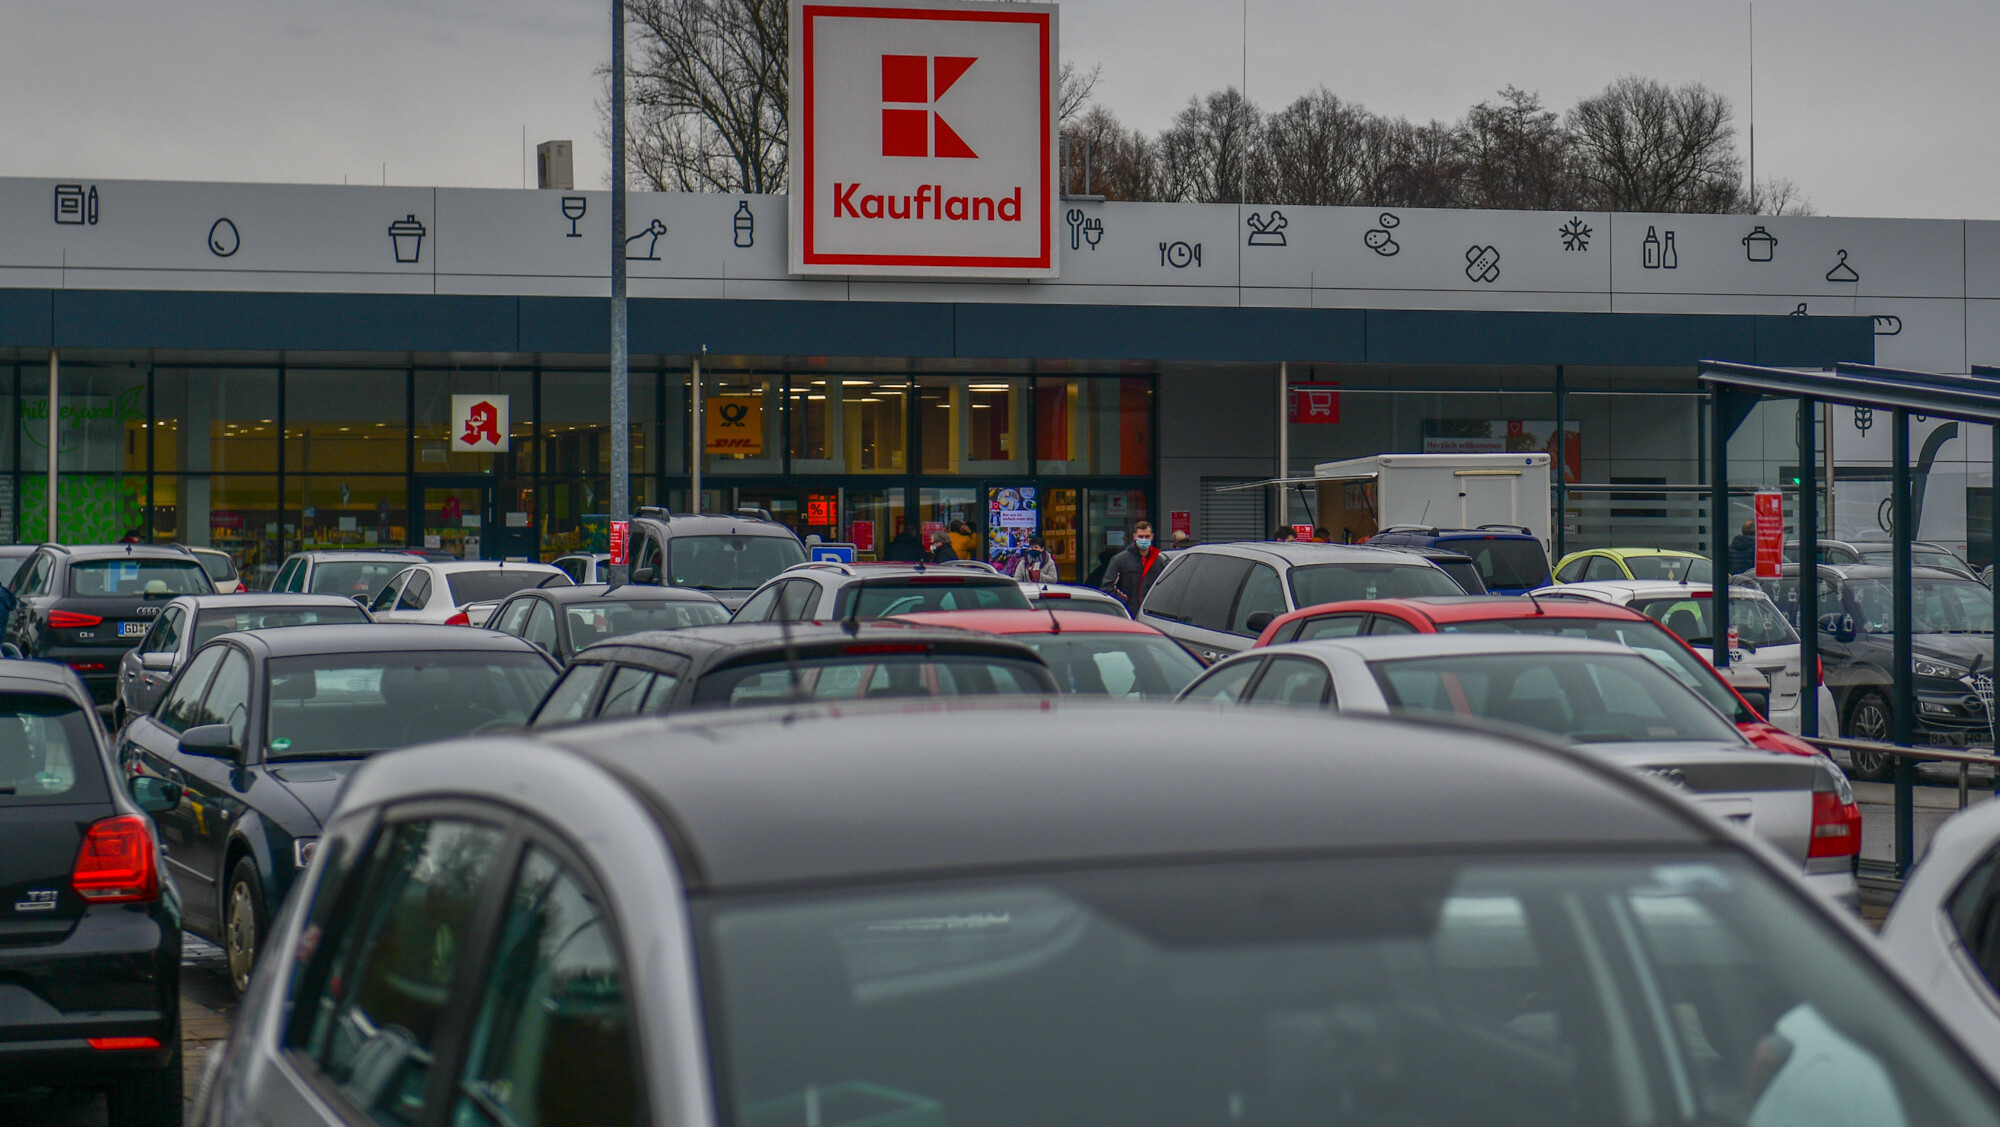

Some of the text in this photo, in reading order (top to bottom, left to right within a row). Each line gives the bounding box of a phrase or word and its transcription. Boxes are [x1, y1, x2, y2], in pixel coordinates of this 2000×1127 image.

[882, 54, 979, 158] K
[833, 182, 1022, 222] Kaufland
[20, 397, 115, 429] hilegard
[460, 400, 502, 446] A
[714, 438, 753, 448] DHL
[1426, 441, 1503, 449] Herzlich willkommen
[125, 623, 138, 633] GD
[27, 890, 58, 901] TSI
